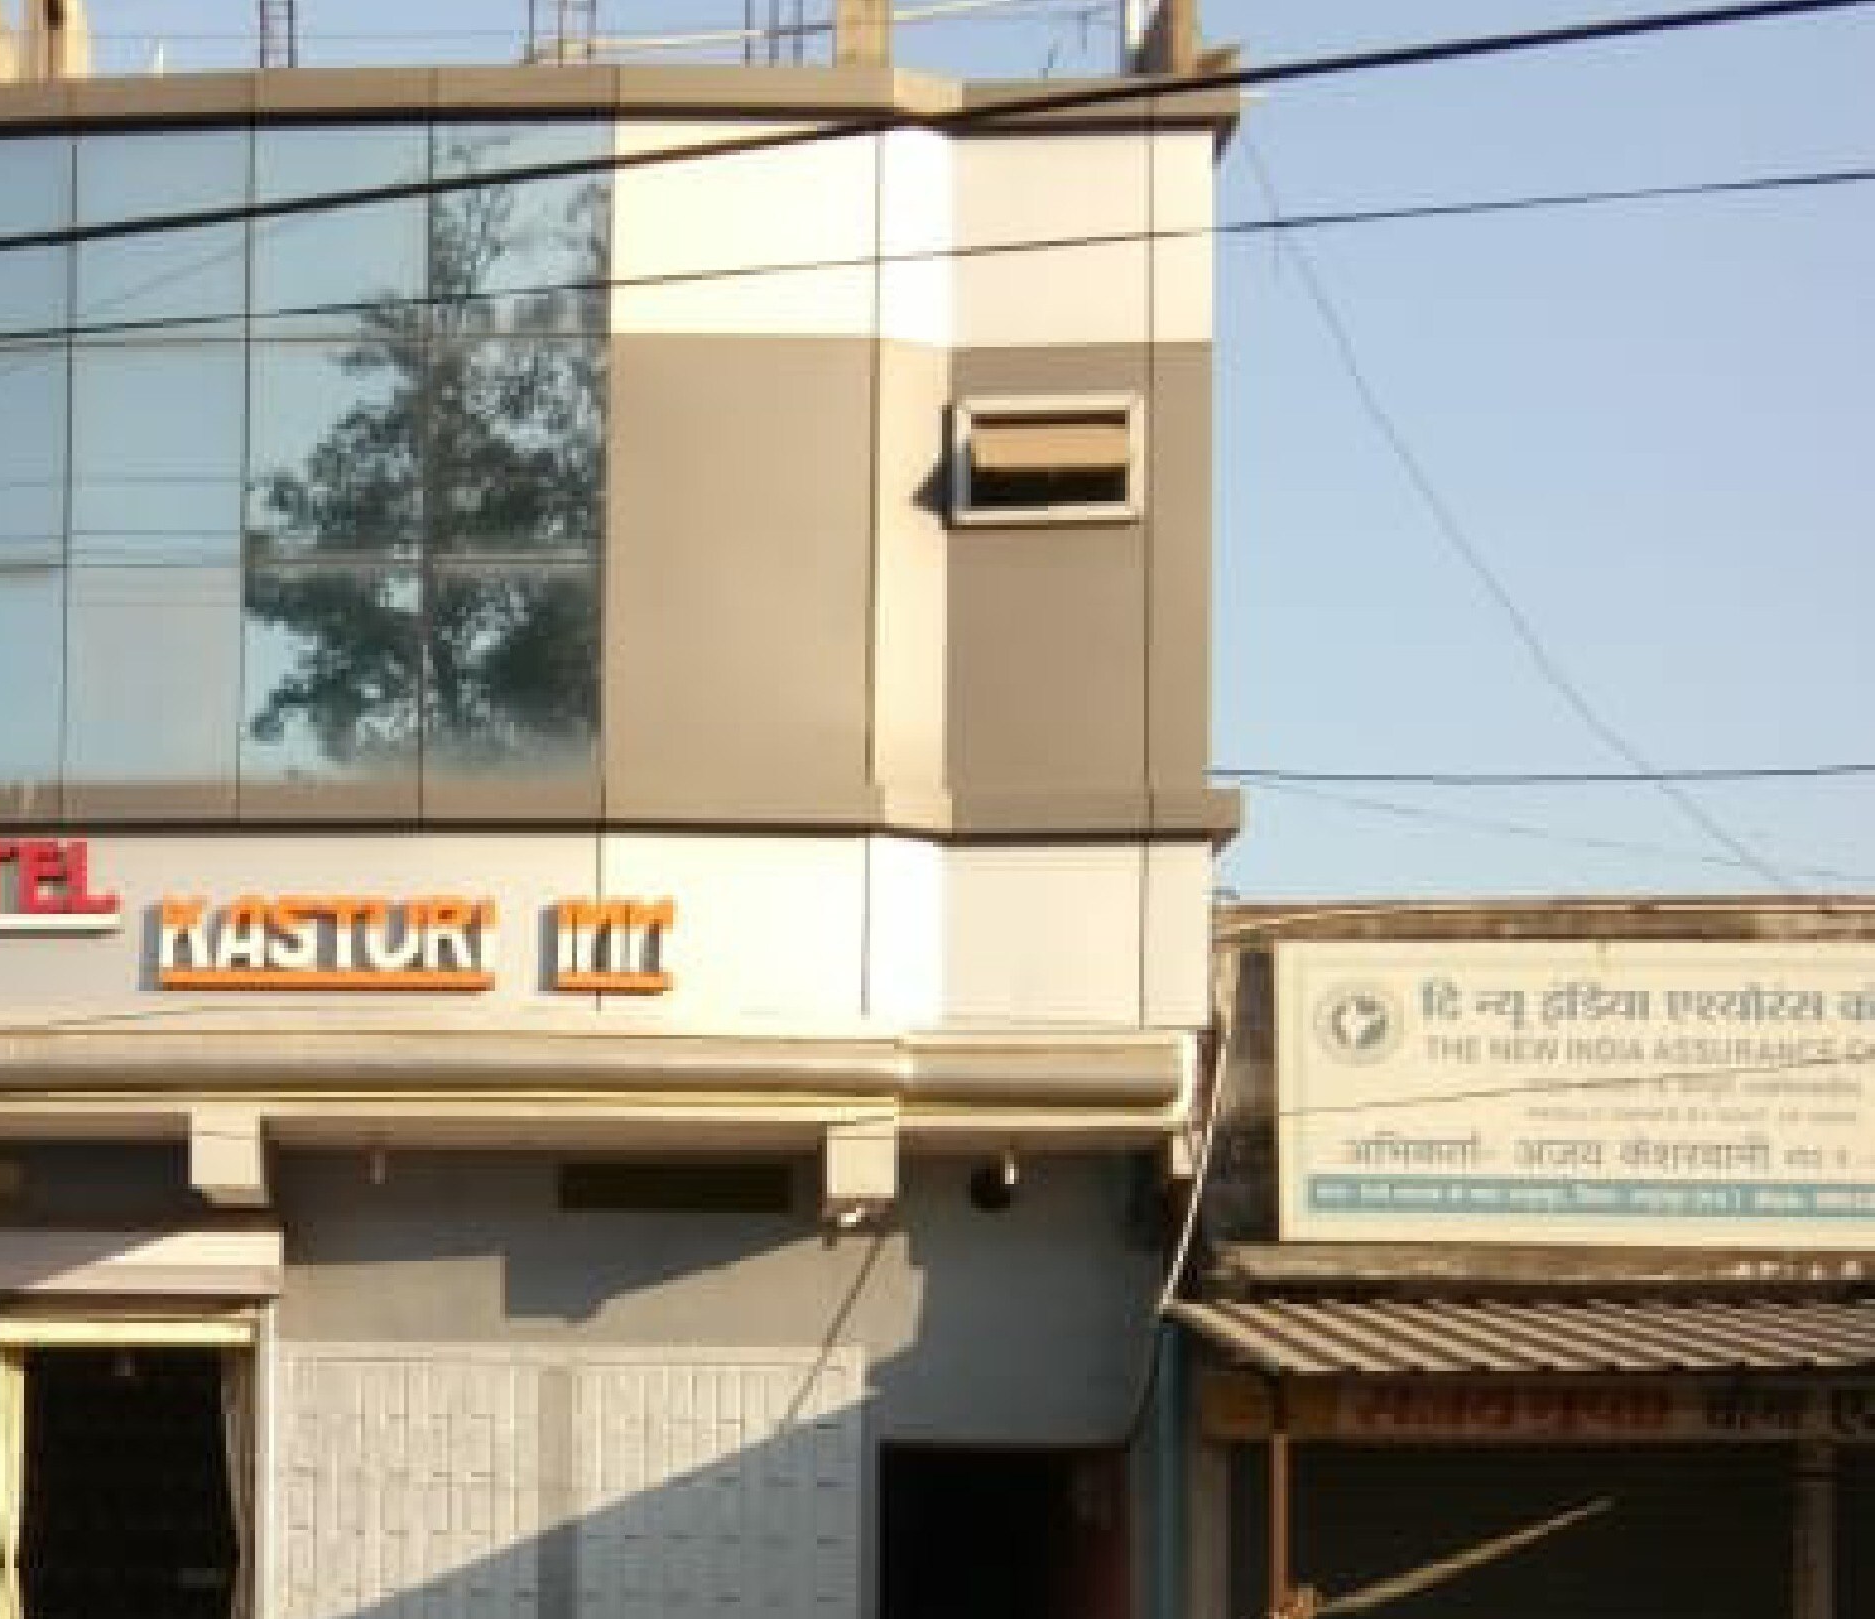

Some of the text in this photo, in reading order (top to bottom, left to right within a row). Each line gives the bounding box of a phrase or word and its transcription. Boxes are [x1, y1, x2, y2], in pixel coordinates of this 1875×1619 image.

[157, 895, 496, 972] KASTURI
[1474, 986, 1525, 1029] न्यू
[1427, 1036, 1480, 1064] THE
[1489, 1036, 1559, 1064] NEW
[1566, 1036, 1646, 1064] INDIA
[1651, 1036, 1835, 1065] ASSURANCE
